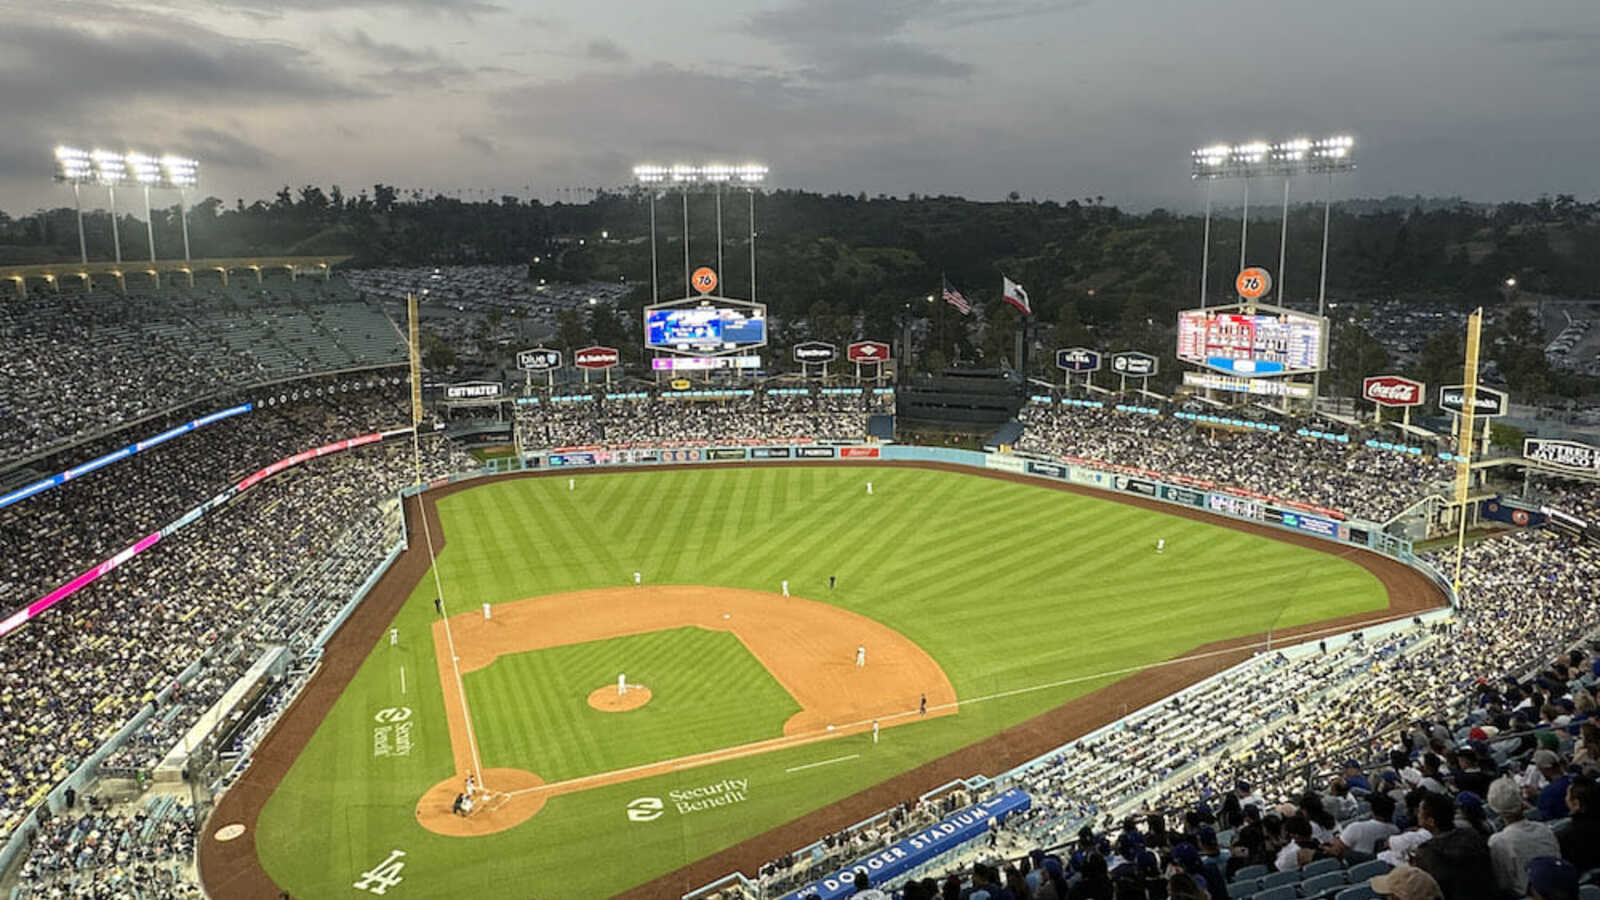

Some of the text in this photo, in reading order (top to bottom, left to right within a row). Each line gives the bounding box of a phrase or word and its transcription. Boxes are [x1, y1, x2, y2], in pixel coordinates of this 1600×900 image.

[697, 275, 712, 286] 76
[1243, 276, 1260, 290] 76
[669, 778, 749, 801] Security
[675, 791, 747, 814] Benefit
[909, 807, 989, 850] STADIUM
